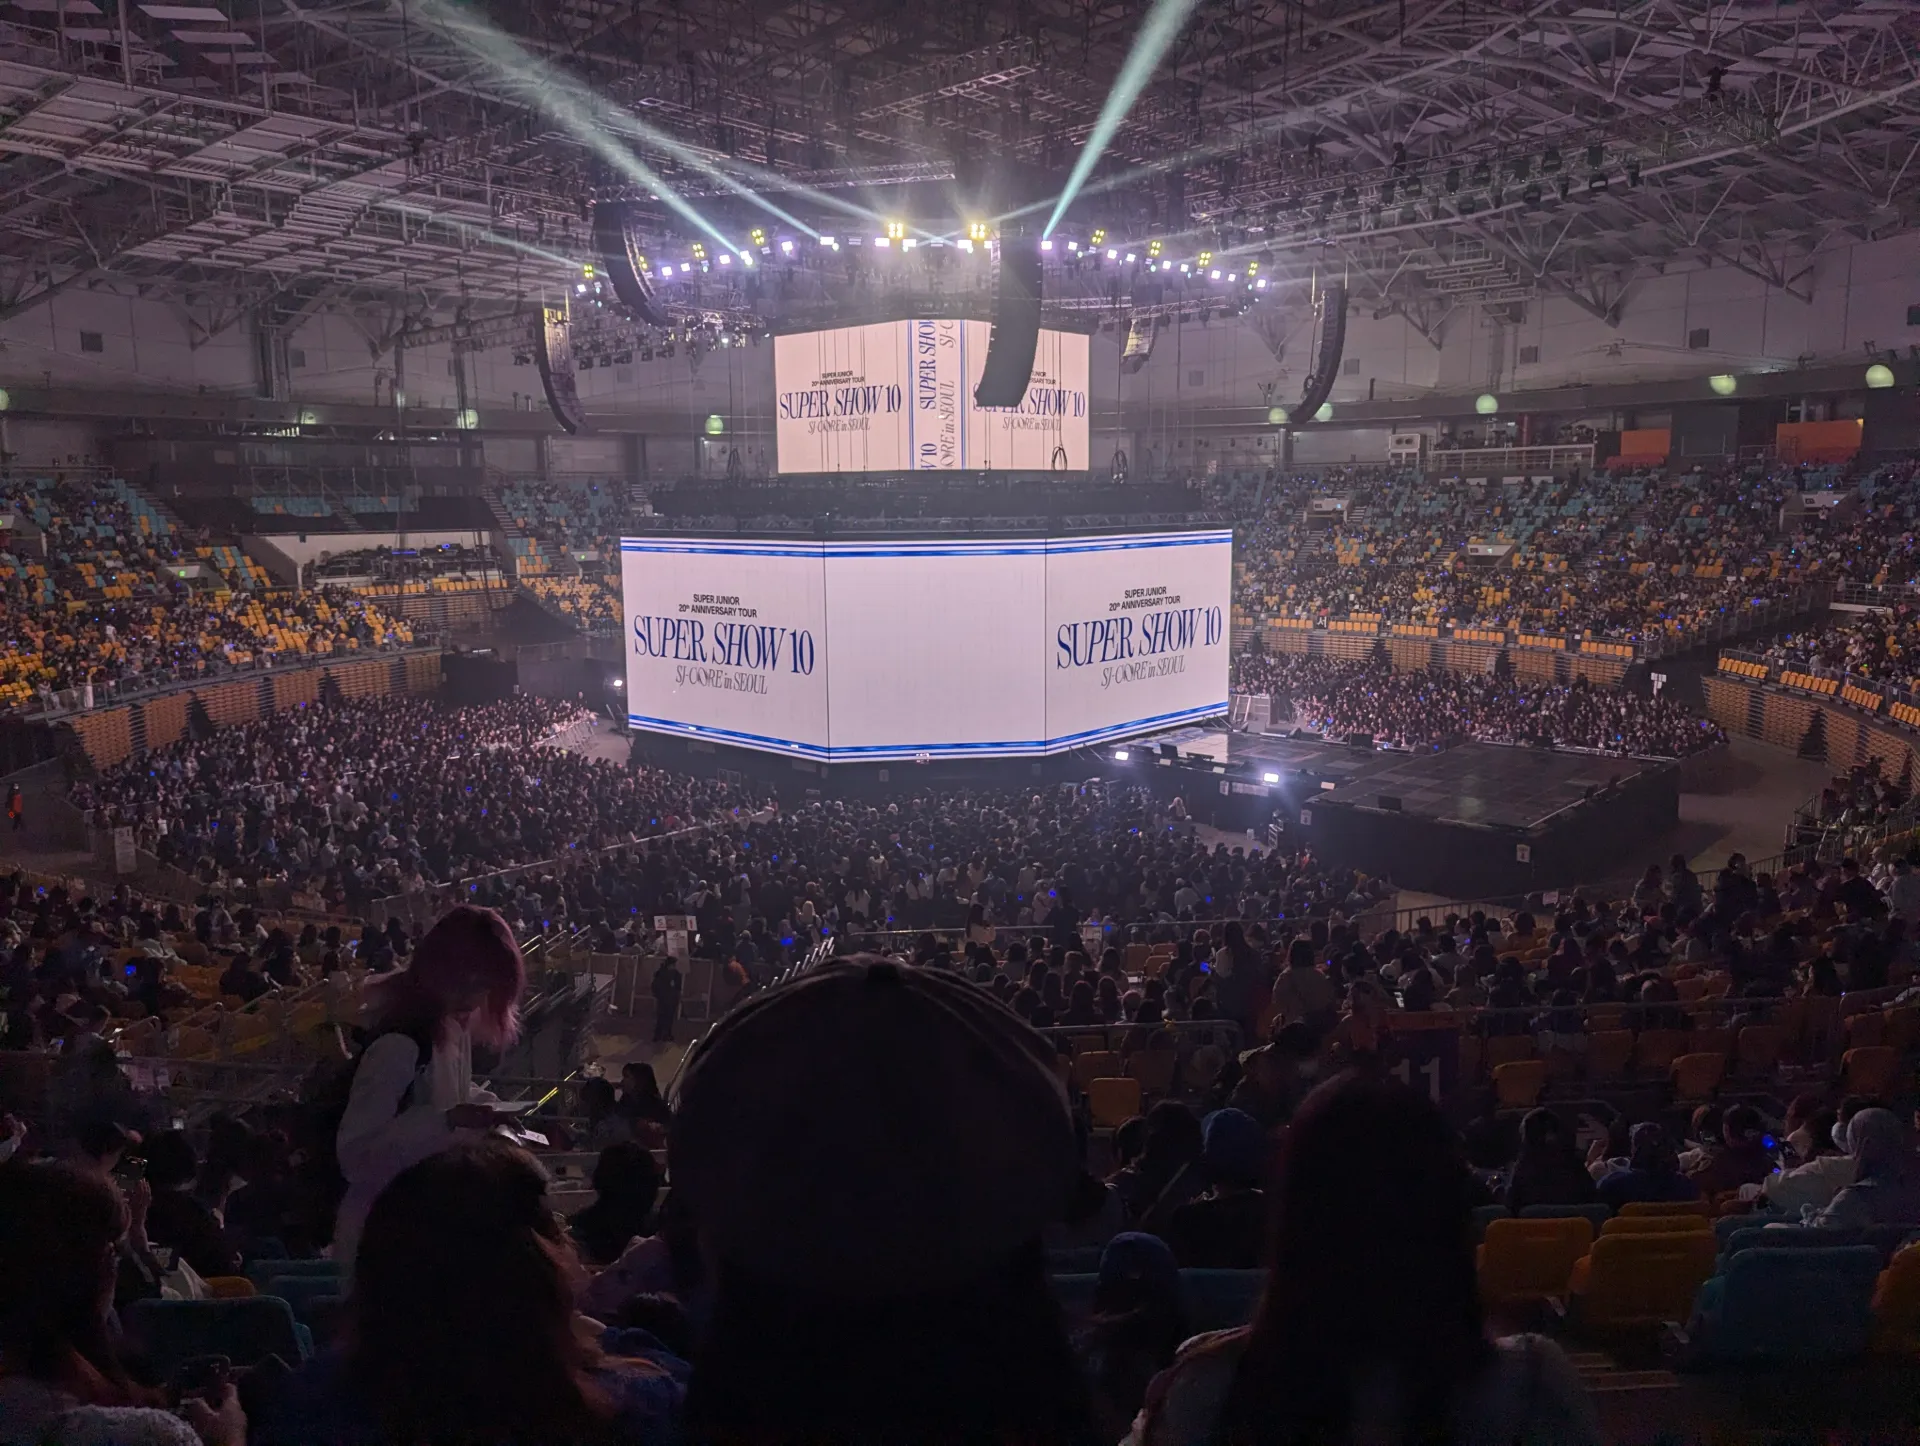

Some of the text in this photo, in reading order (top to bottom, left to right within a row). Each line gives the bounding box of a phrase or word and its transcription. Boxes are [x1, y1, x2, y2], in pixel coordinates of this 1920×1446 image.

[918, 319, 936, 357] SHO
[918, 359, 937, 410] SUPER
[779, 384, 902, 419] SUPER SHOW 10
[939, 380, 955, 422] SEOUL
[1028, 388, 1072, 416] SHOW
[1073, 391, 1086, 418] 10
[693, 593, 740, 606] SUPER JUNIOR
[1121, 597, 1163, 610] ANNIVERSARY
[1164, 595, 1180, 604] TOUR
[1124, 586, 1167, 599] SUPER JUNIOR
[691, 604, 737, 616] ANNIVERSARY
[738, 608, 757, 618] TOUR
[634, 615, 815, 675] SUPER SHOW 10
[1057, 605, 1222, 670] SUPER SHOW 10
[724, 672, 733, 690] in
[733, 672, 768, 695] SEOUL
[1148, 662, 1156, 682] in
[1156, 655, 1186, 677] SEOUL
